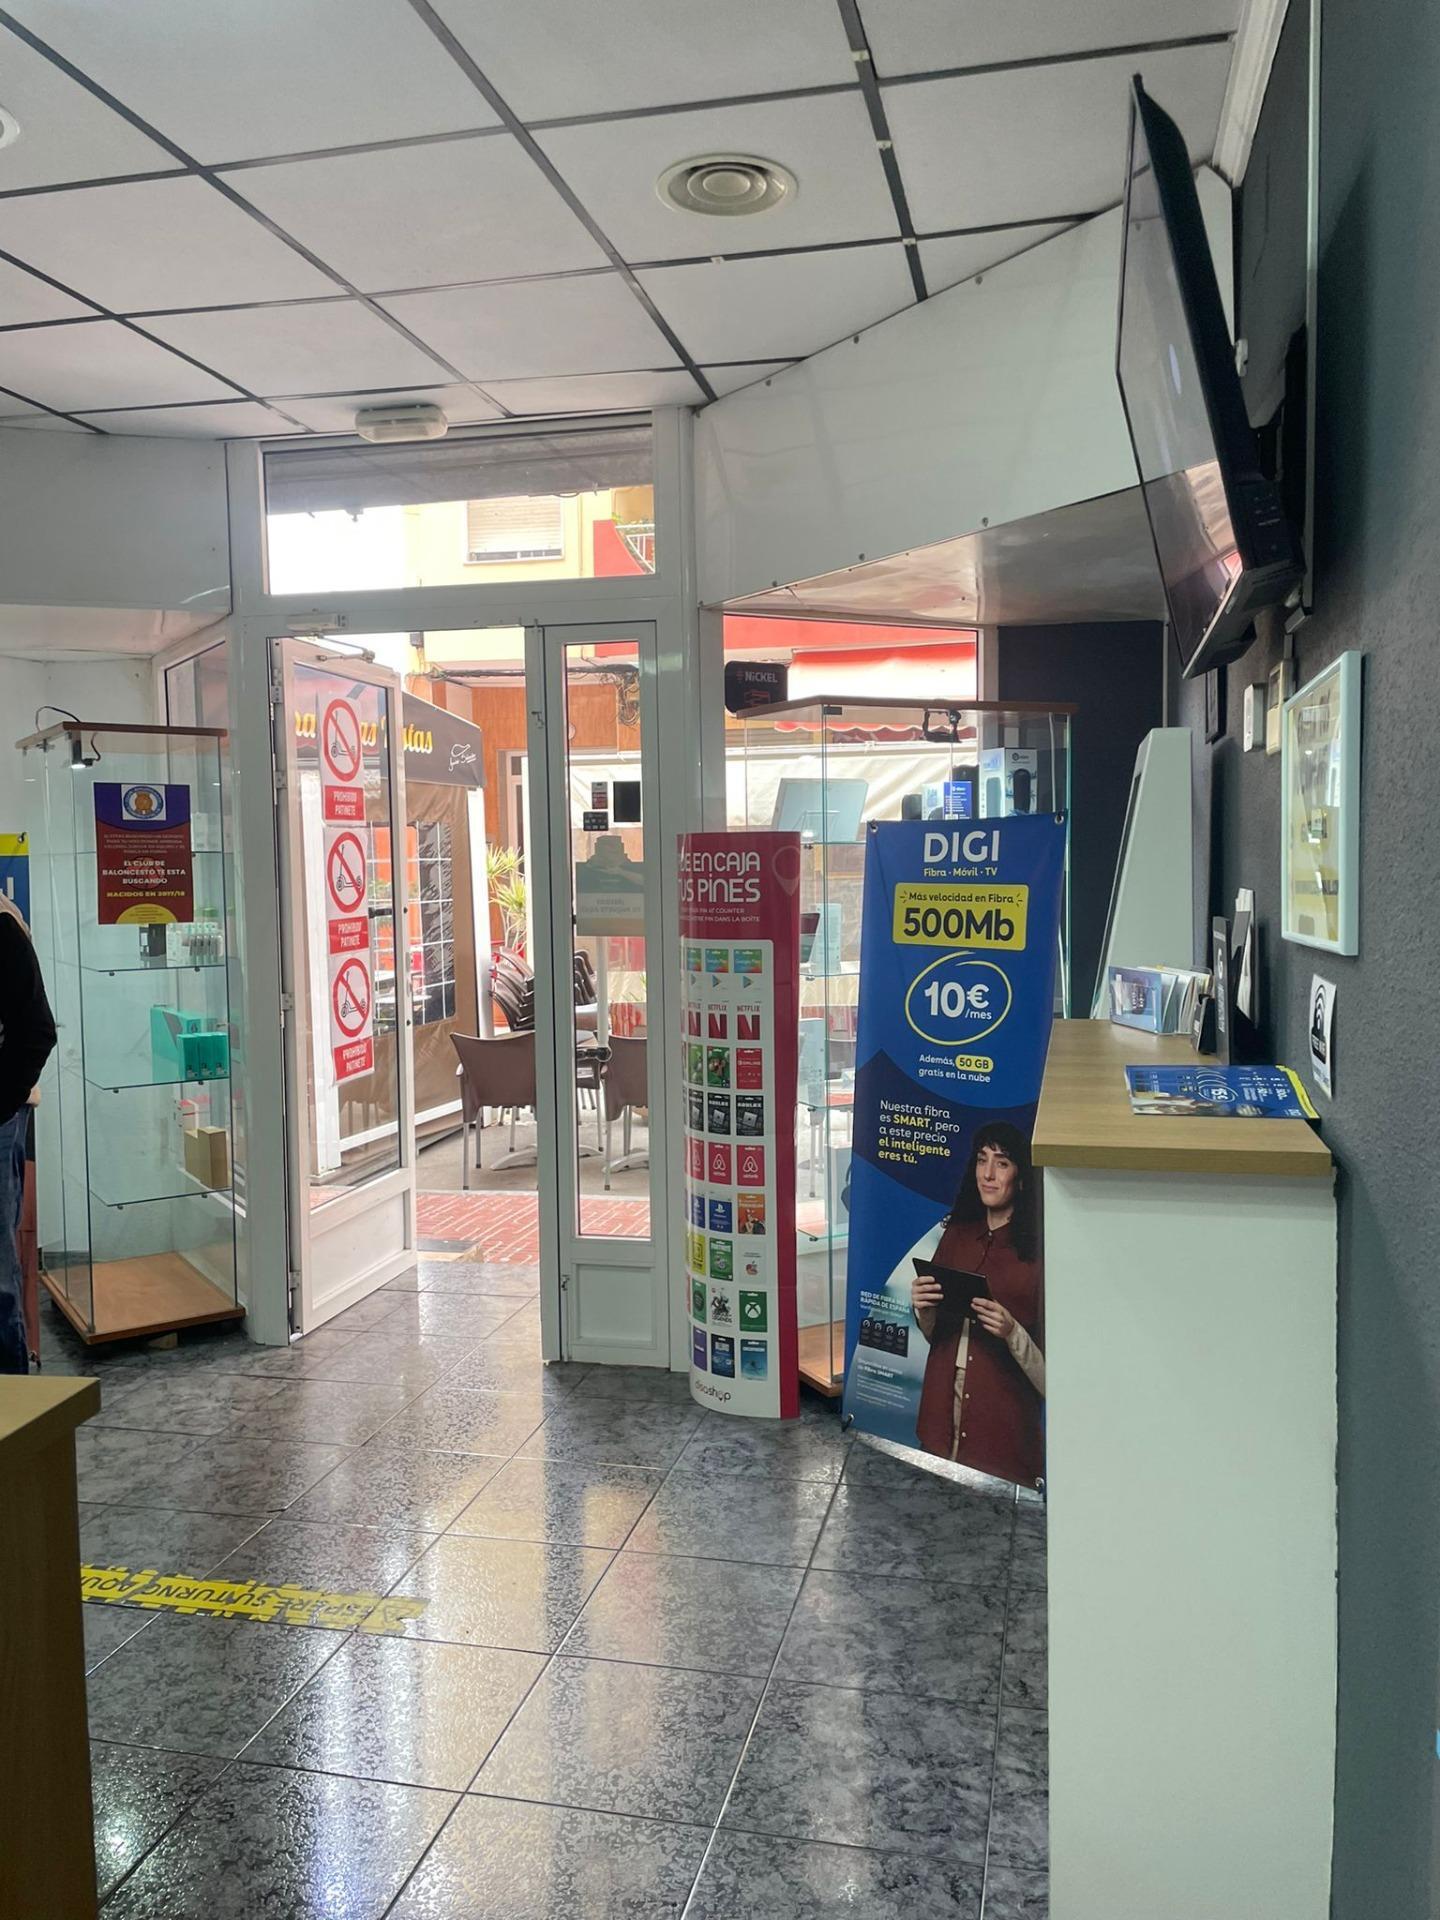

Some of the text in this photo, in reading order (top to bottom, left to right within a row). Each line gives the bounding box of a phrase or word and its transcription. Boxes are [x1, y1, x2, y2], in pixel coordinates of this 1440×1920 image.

[923, 830, 1000, 863] DIGI
[714, 851, 761, 876] CAJA
[923, 866, 998, 877] Fibra Móvil TV
[908, 891, 1014, 904] Más velocidad en Fibra
[903, 906, 1015, 942] 500Mb
[924, 980, 990, 1018] 10€
[965, 1008, 992, 1020] /mes
[918, 1054, 989, 1070] Además, 50 GB
[918, 1067, 991, 1083] gratis en la nube
[880, 1099, 951, 1119] Nuestra fibra
[879, 1113, 960, 1134] es SMART, pero
[879, 1126, 947, 1144] a este precio
[878, 1137, 951, 1157] el inteligente
[878, 1151, 918, 1164] eres tú.
